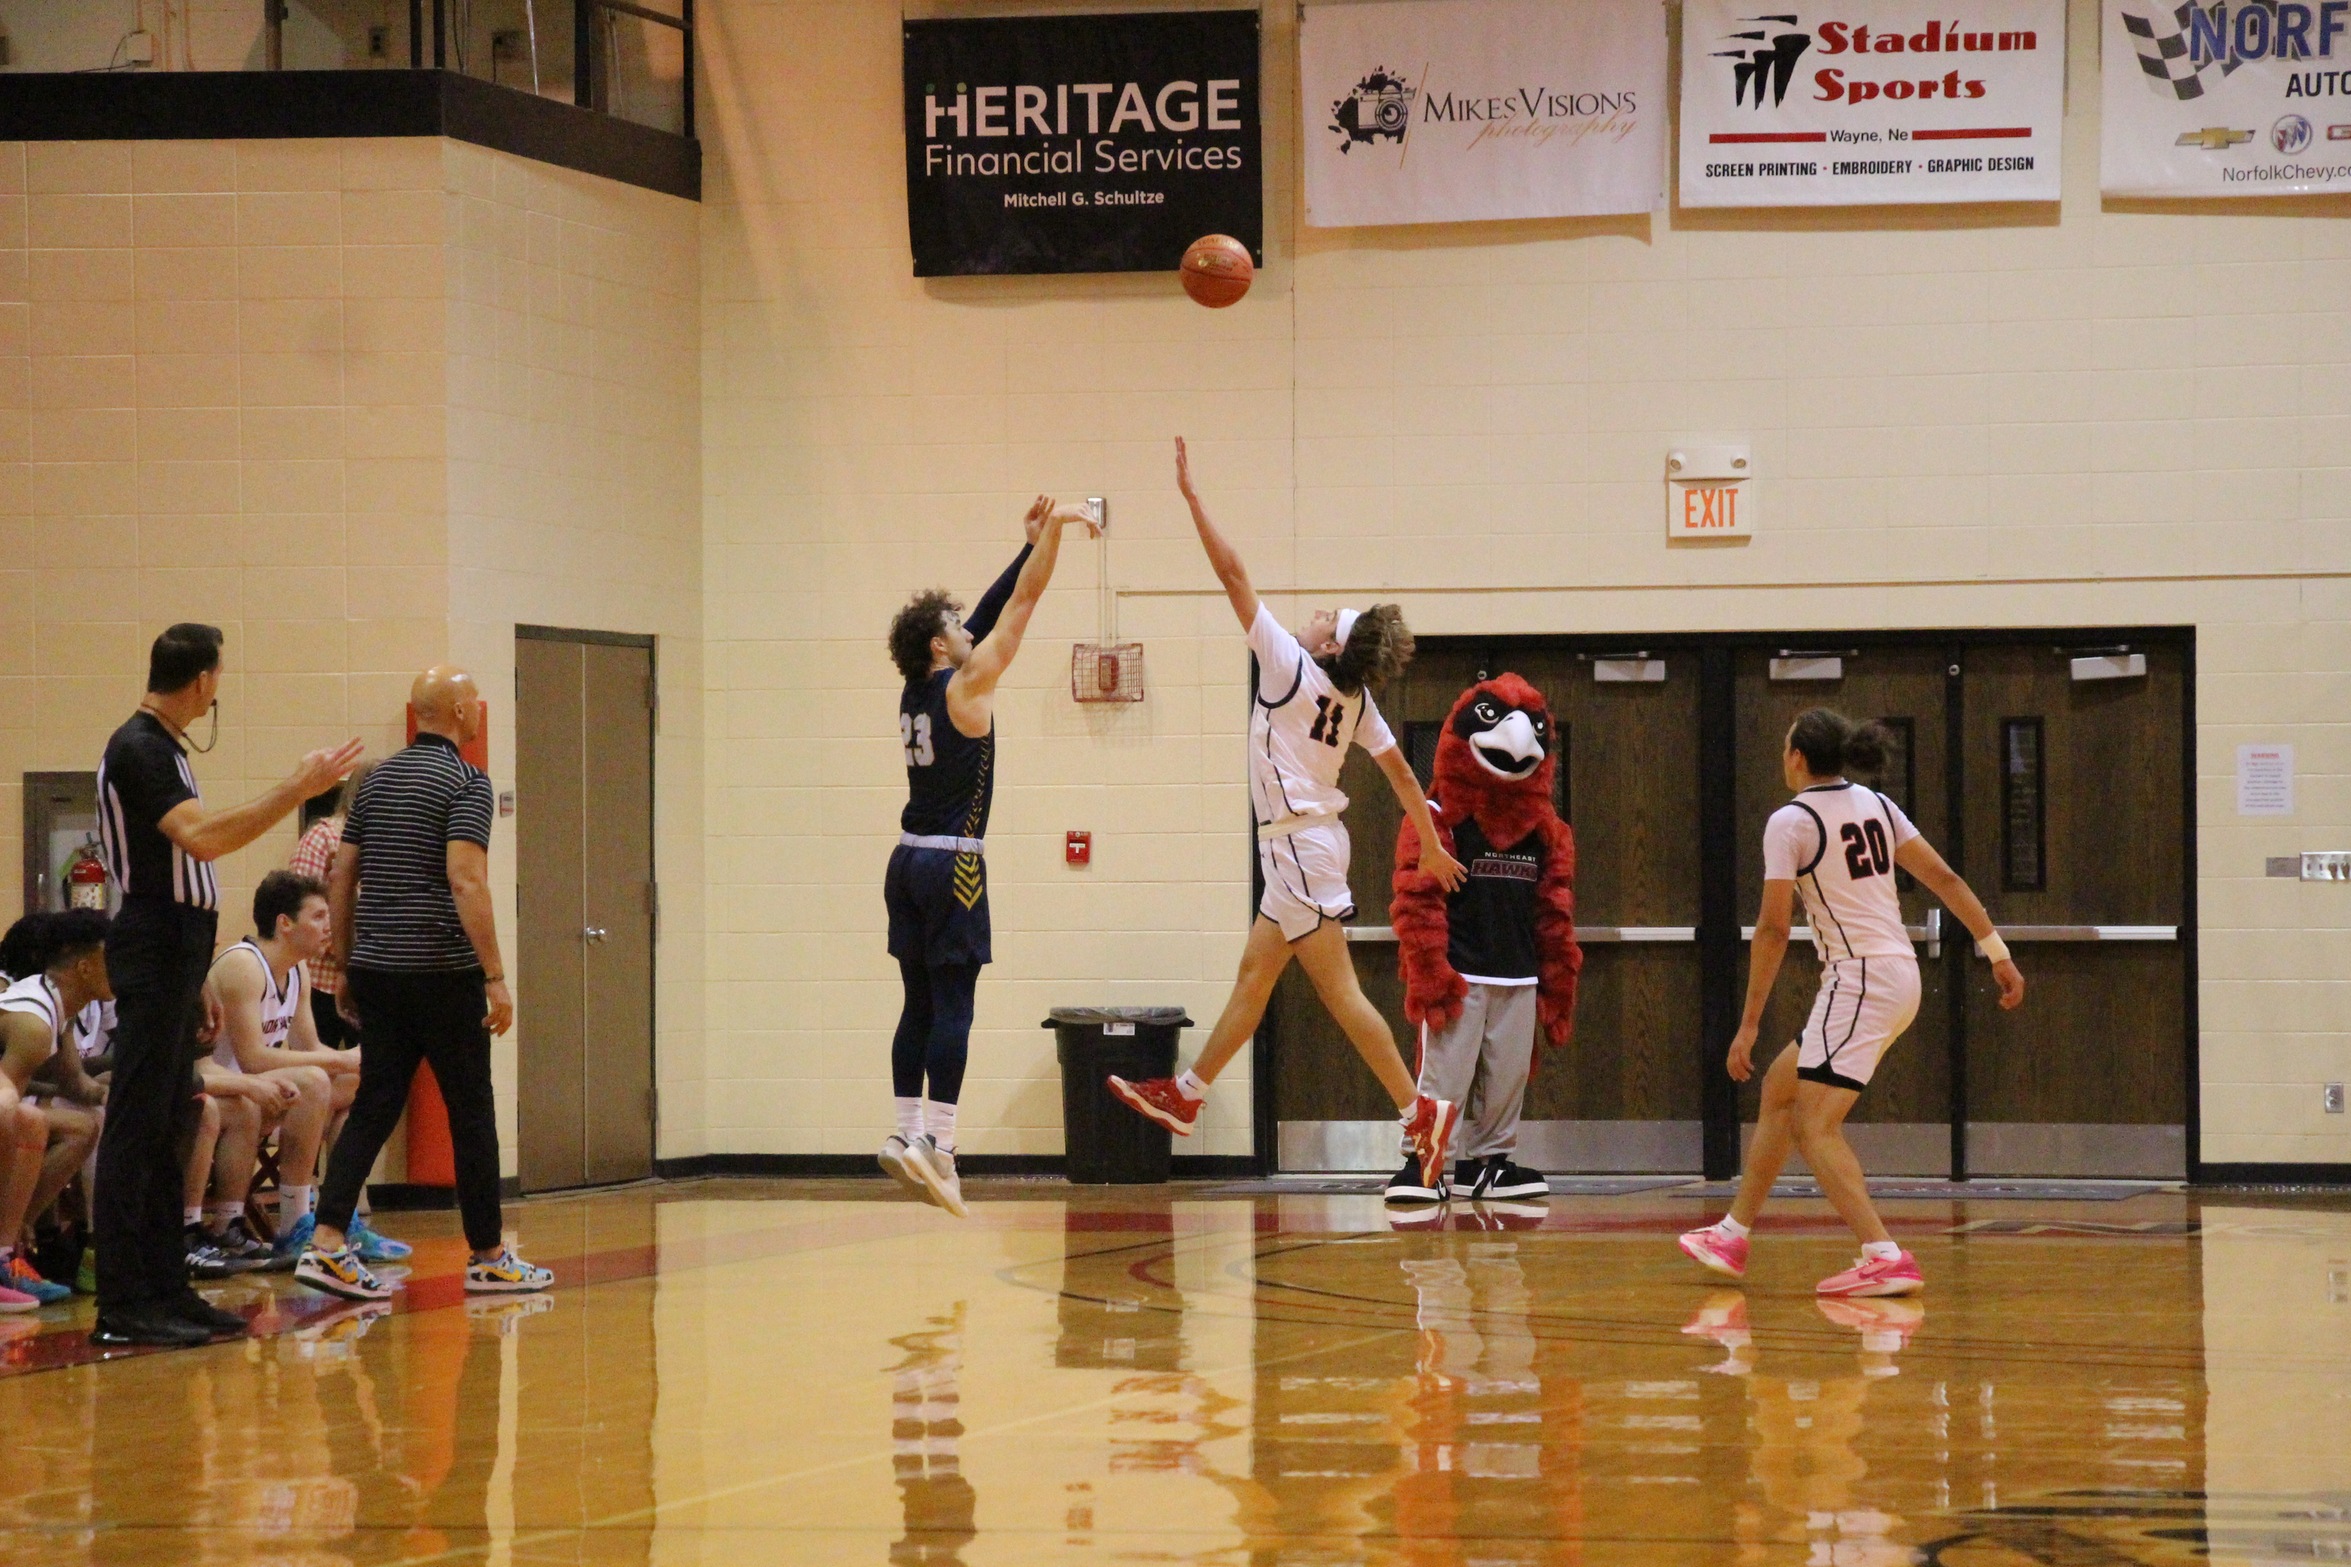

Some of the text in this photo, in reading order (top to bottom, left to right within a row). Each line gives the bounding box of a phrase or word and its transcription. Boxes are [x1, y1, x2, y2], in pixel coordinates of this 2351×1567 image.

[1812, 68, 1987, 105] Sports
[925, 79, 1241, 138] HERITAGE
[1830, 128, 1909, 144] Wayne, Ne
[926, 138, 1242, 176] Financial Services
[1705, 156, 2035, 178] SCREEN PRINTING EMBROIDERY GRAPHIC DESIGN
[1003, 190, 1165, 208] Mitchell G. Schultze
[1684, 488, 1739, 528] EXIT
[900, 712, 936, 767] 23
[1840, 818, 1891, 881] 20
